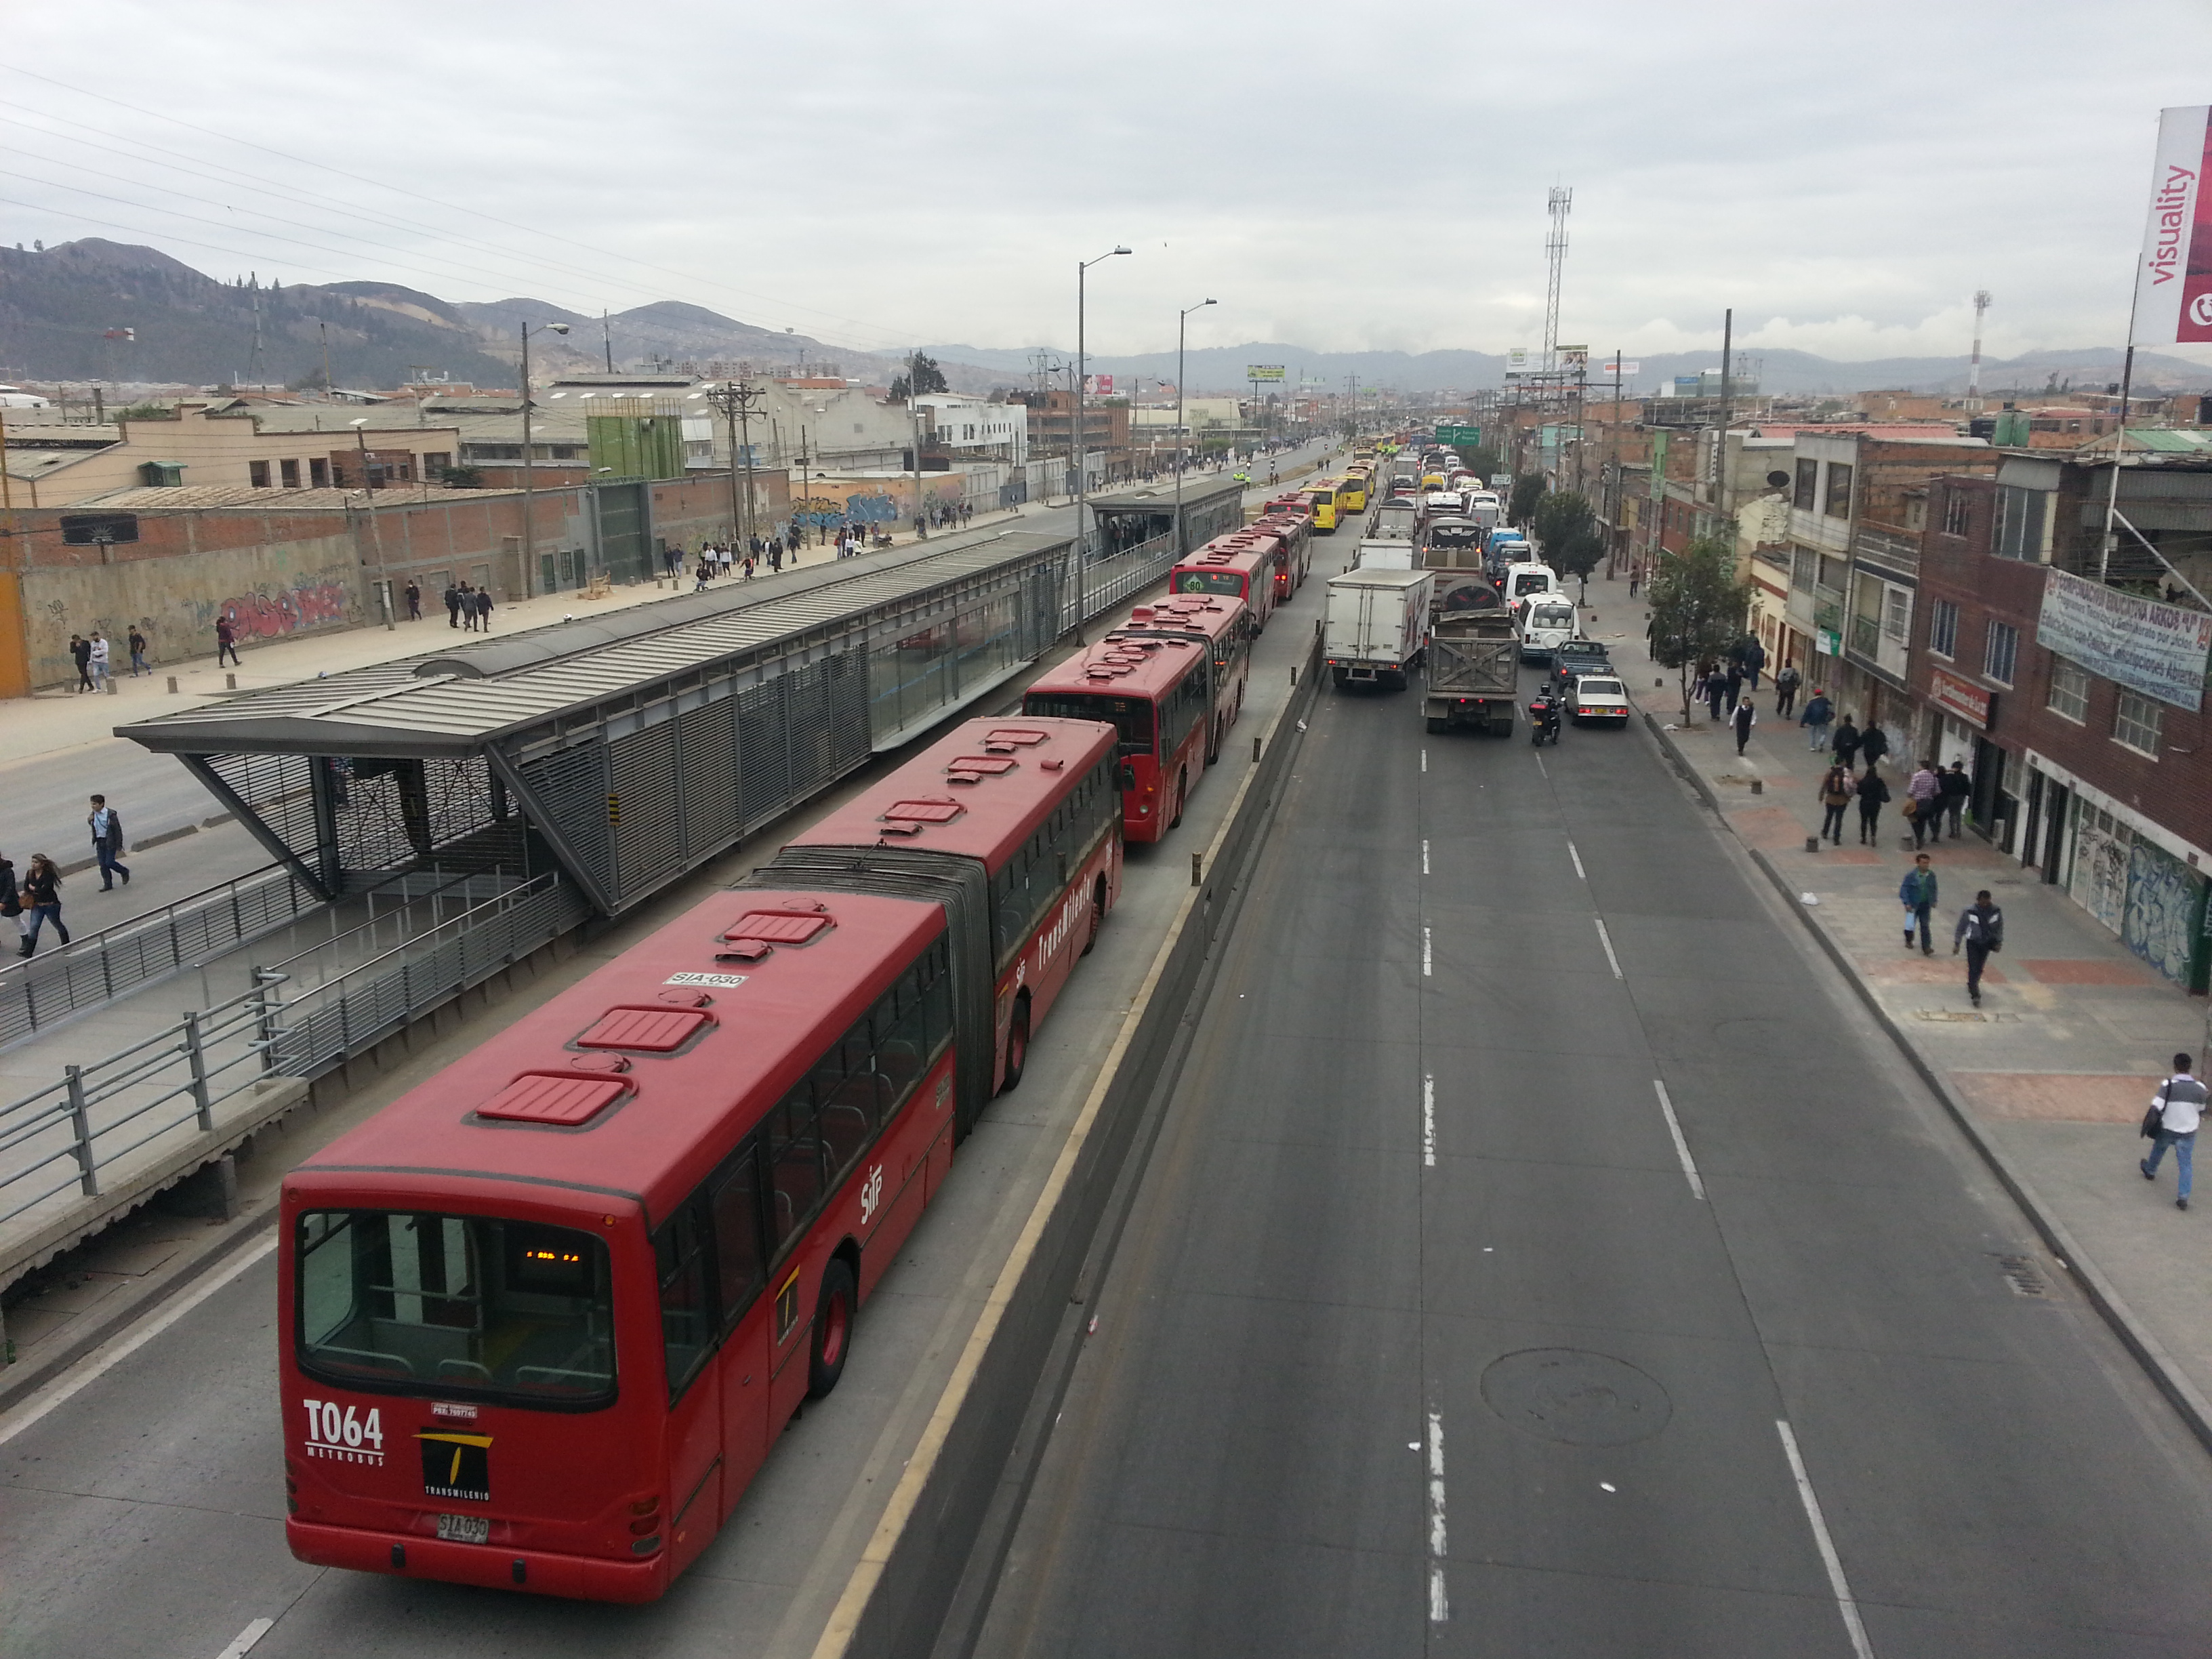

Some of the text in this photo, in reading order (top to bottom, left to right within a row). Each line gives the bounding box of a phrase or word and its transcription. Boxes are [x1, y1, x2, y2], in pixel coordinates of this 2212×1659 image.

[2148, 164, 2196, 285] visuality
[1190, 581, 1200, 590] 80
[2150, 604, 2180, 630] ARKOS
[672, 973, 742, 984] SIA-030
[303, 1399, 384, 1450] T064
[307, 1446, 383, 1467] METROBUS
[425, 1486, 489, 1501] TRANSMILENIO
